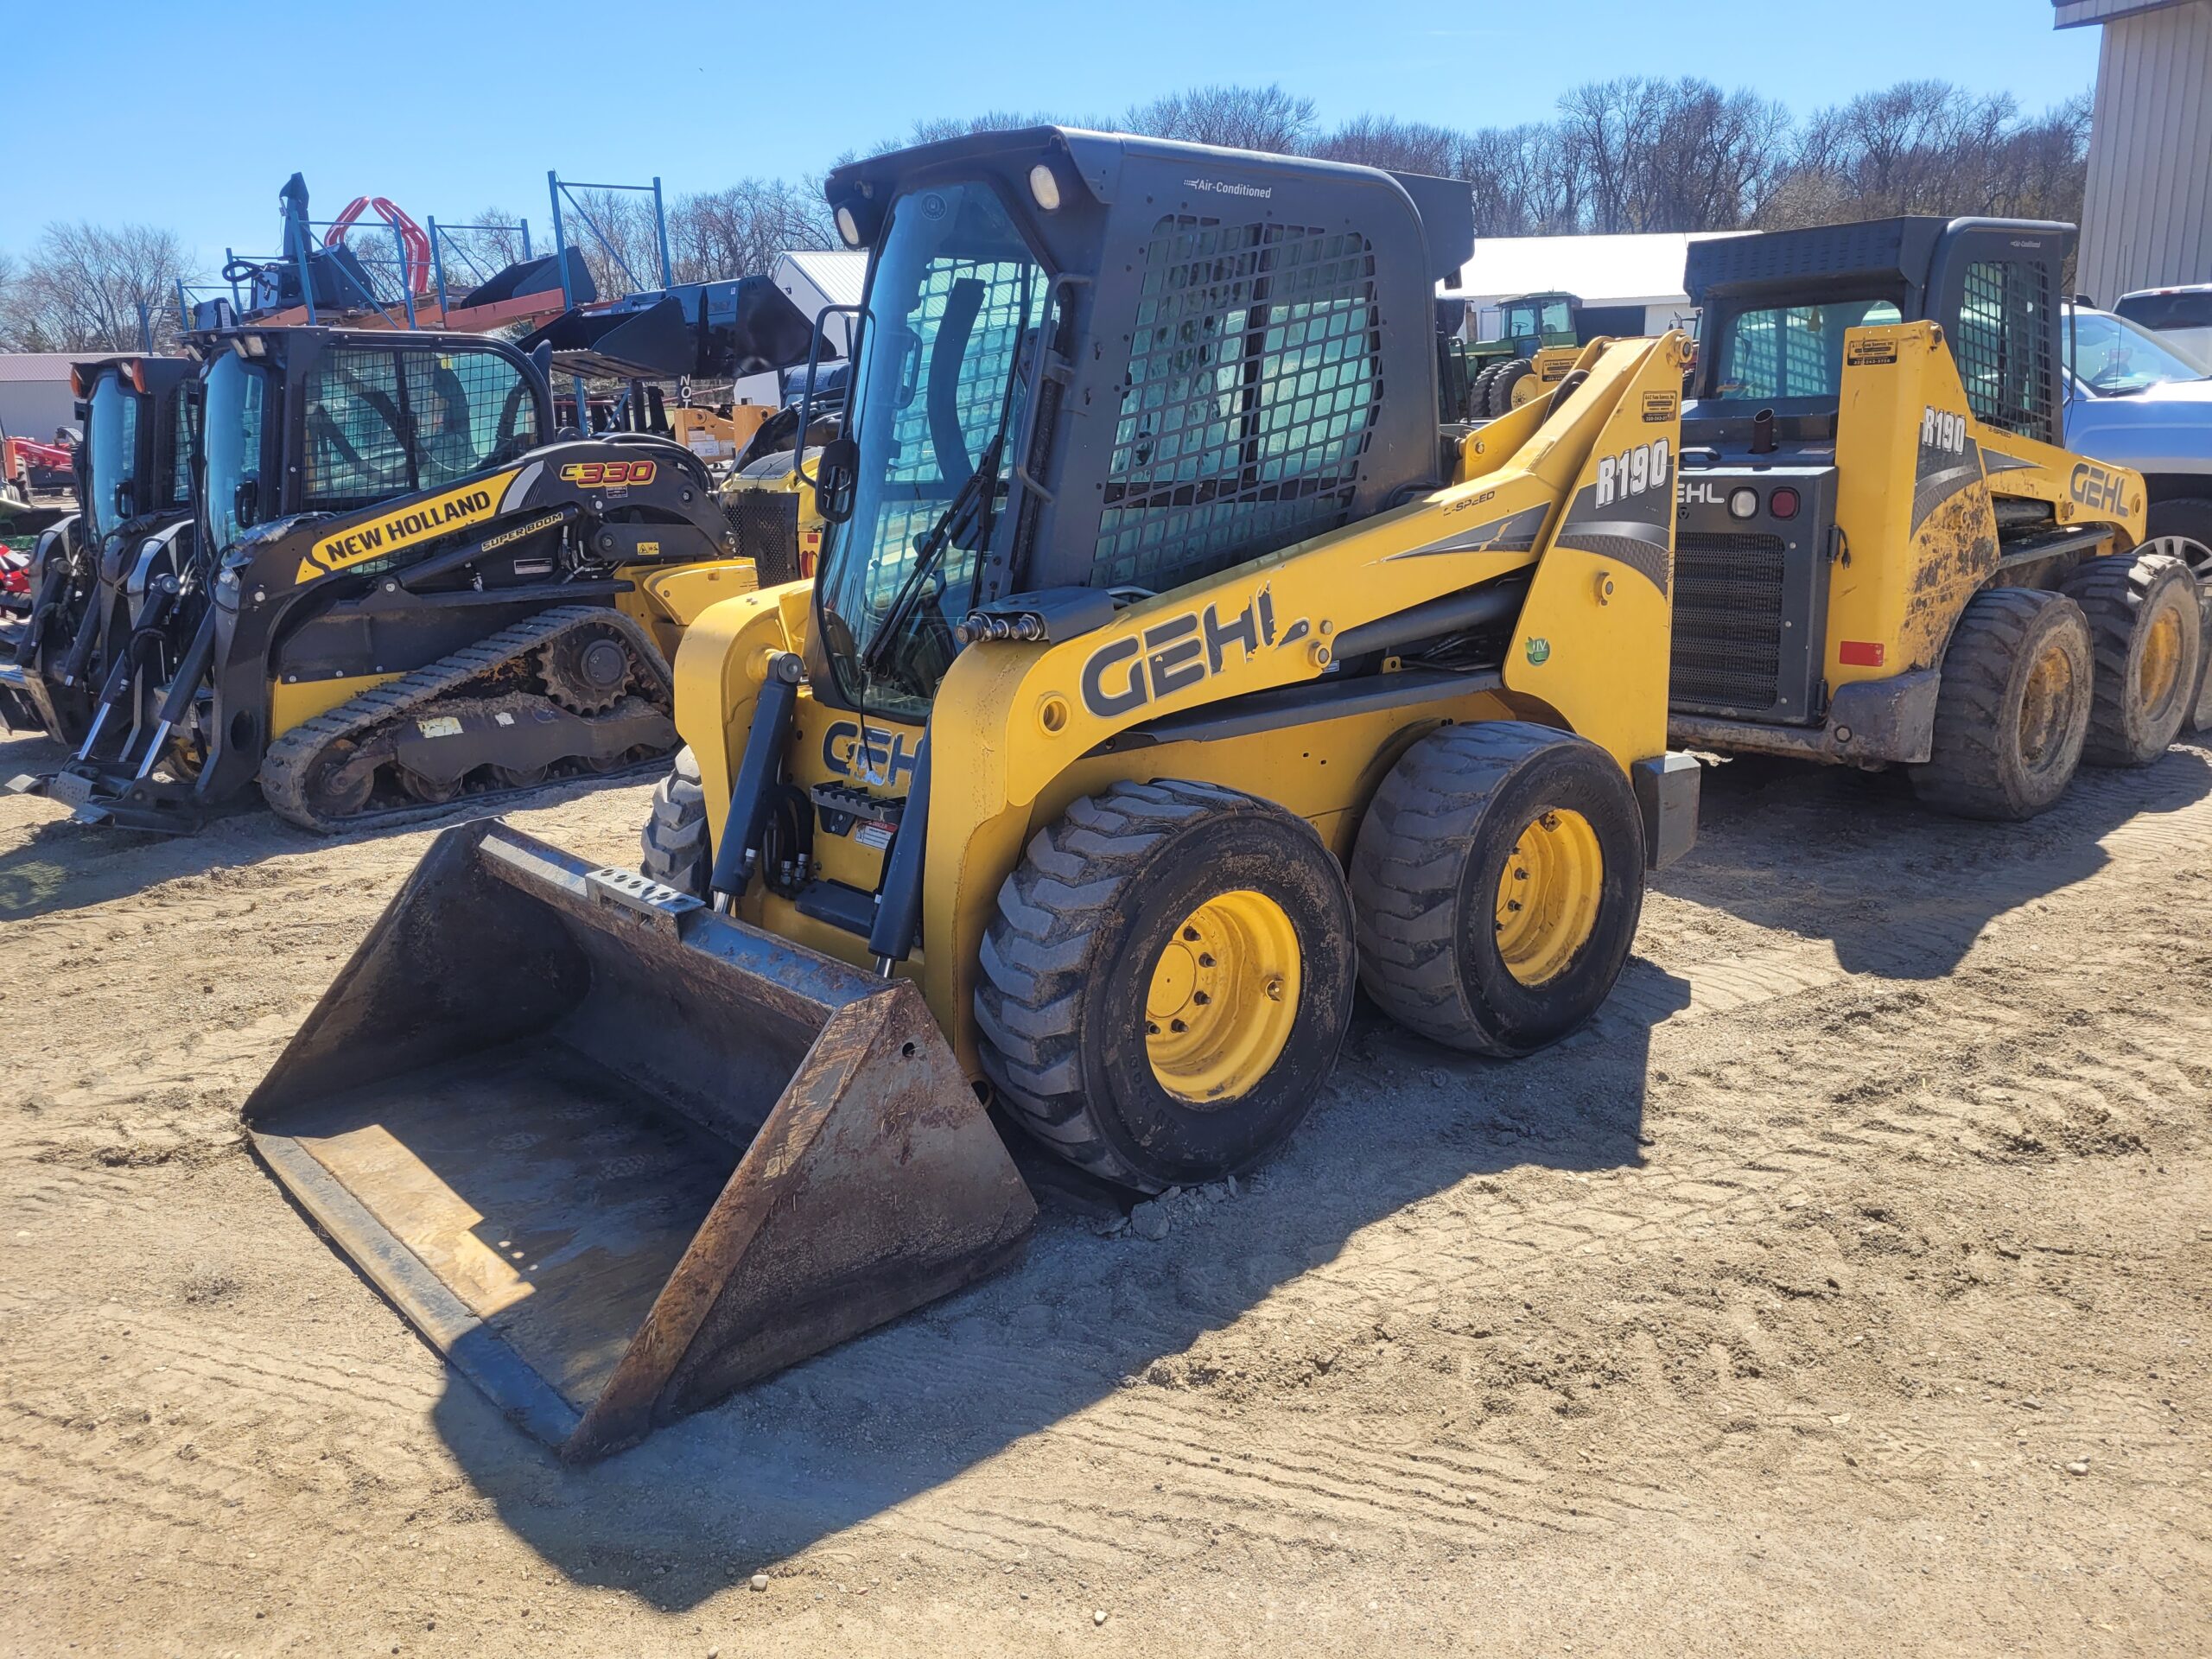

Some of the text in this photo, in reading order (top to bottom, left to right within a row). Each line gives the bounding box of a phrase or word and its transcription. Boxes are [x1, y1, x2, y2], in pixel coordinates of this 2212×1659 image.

[1198, 179, 1272, 198] Air-Conditioned
[1922, 405, 1966, 455] R190
[560, 461, 658, 488] C330
[1595, 436, 1669, 510] R190
[1676, 483, 1725, 504] EHL
[2069, 461, 2129, 518] GEHL
[325, 491, 491, 563] NEW HOLLAND
[481, 512, 563, 551] SUPER BOOM
[1080, 580, 1310, 718] GEHL
[822, 719, 924, 787] GEH
